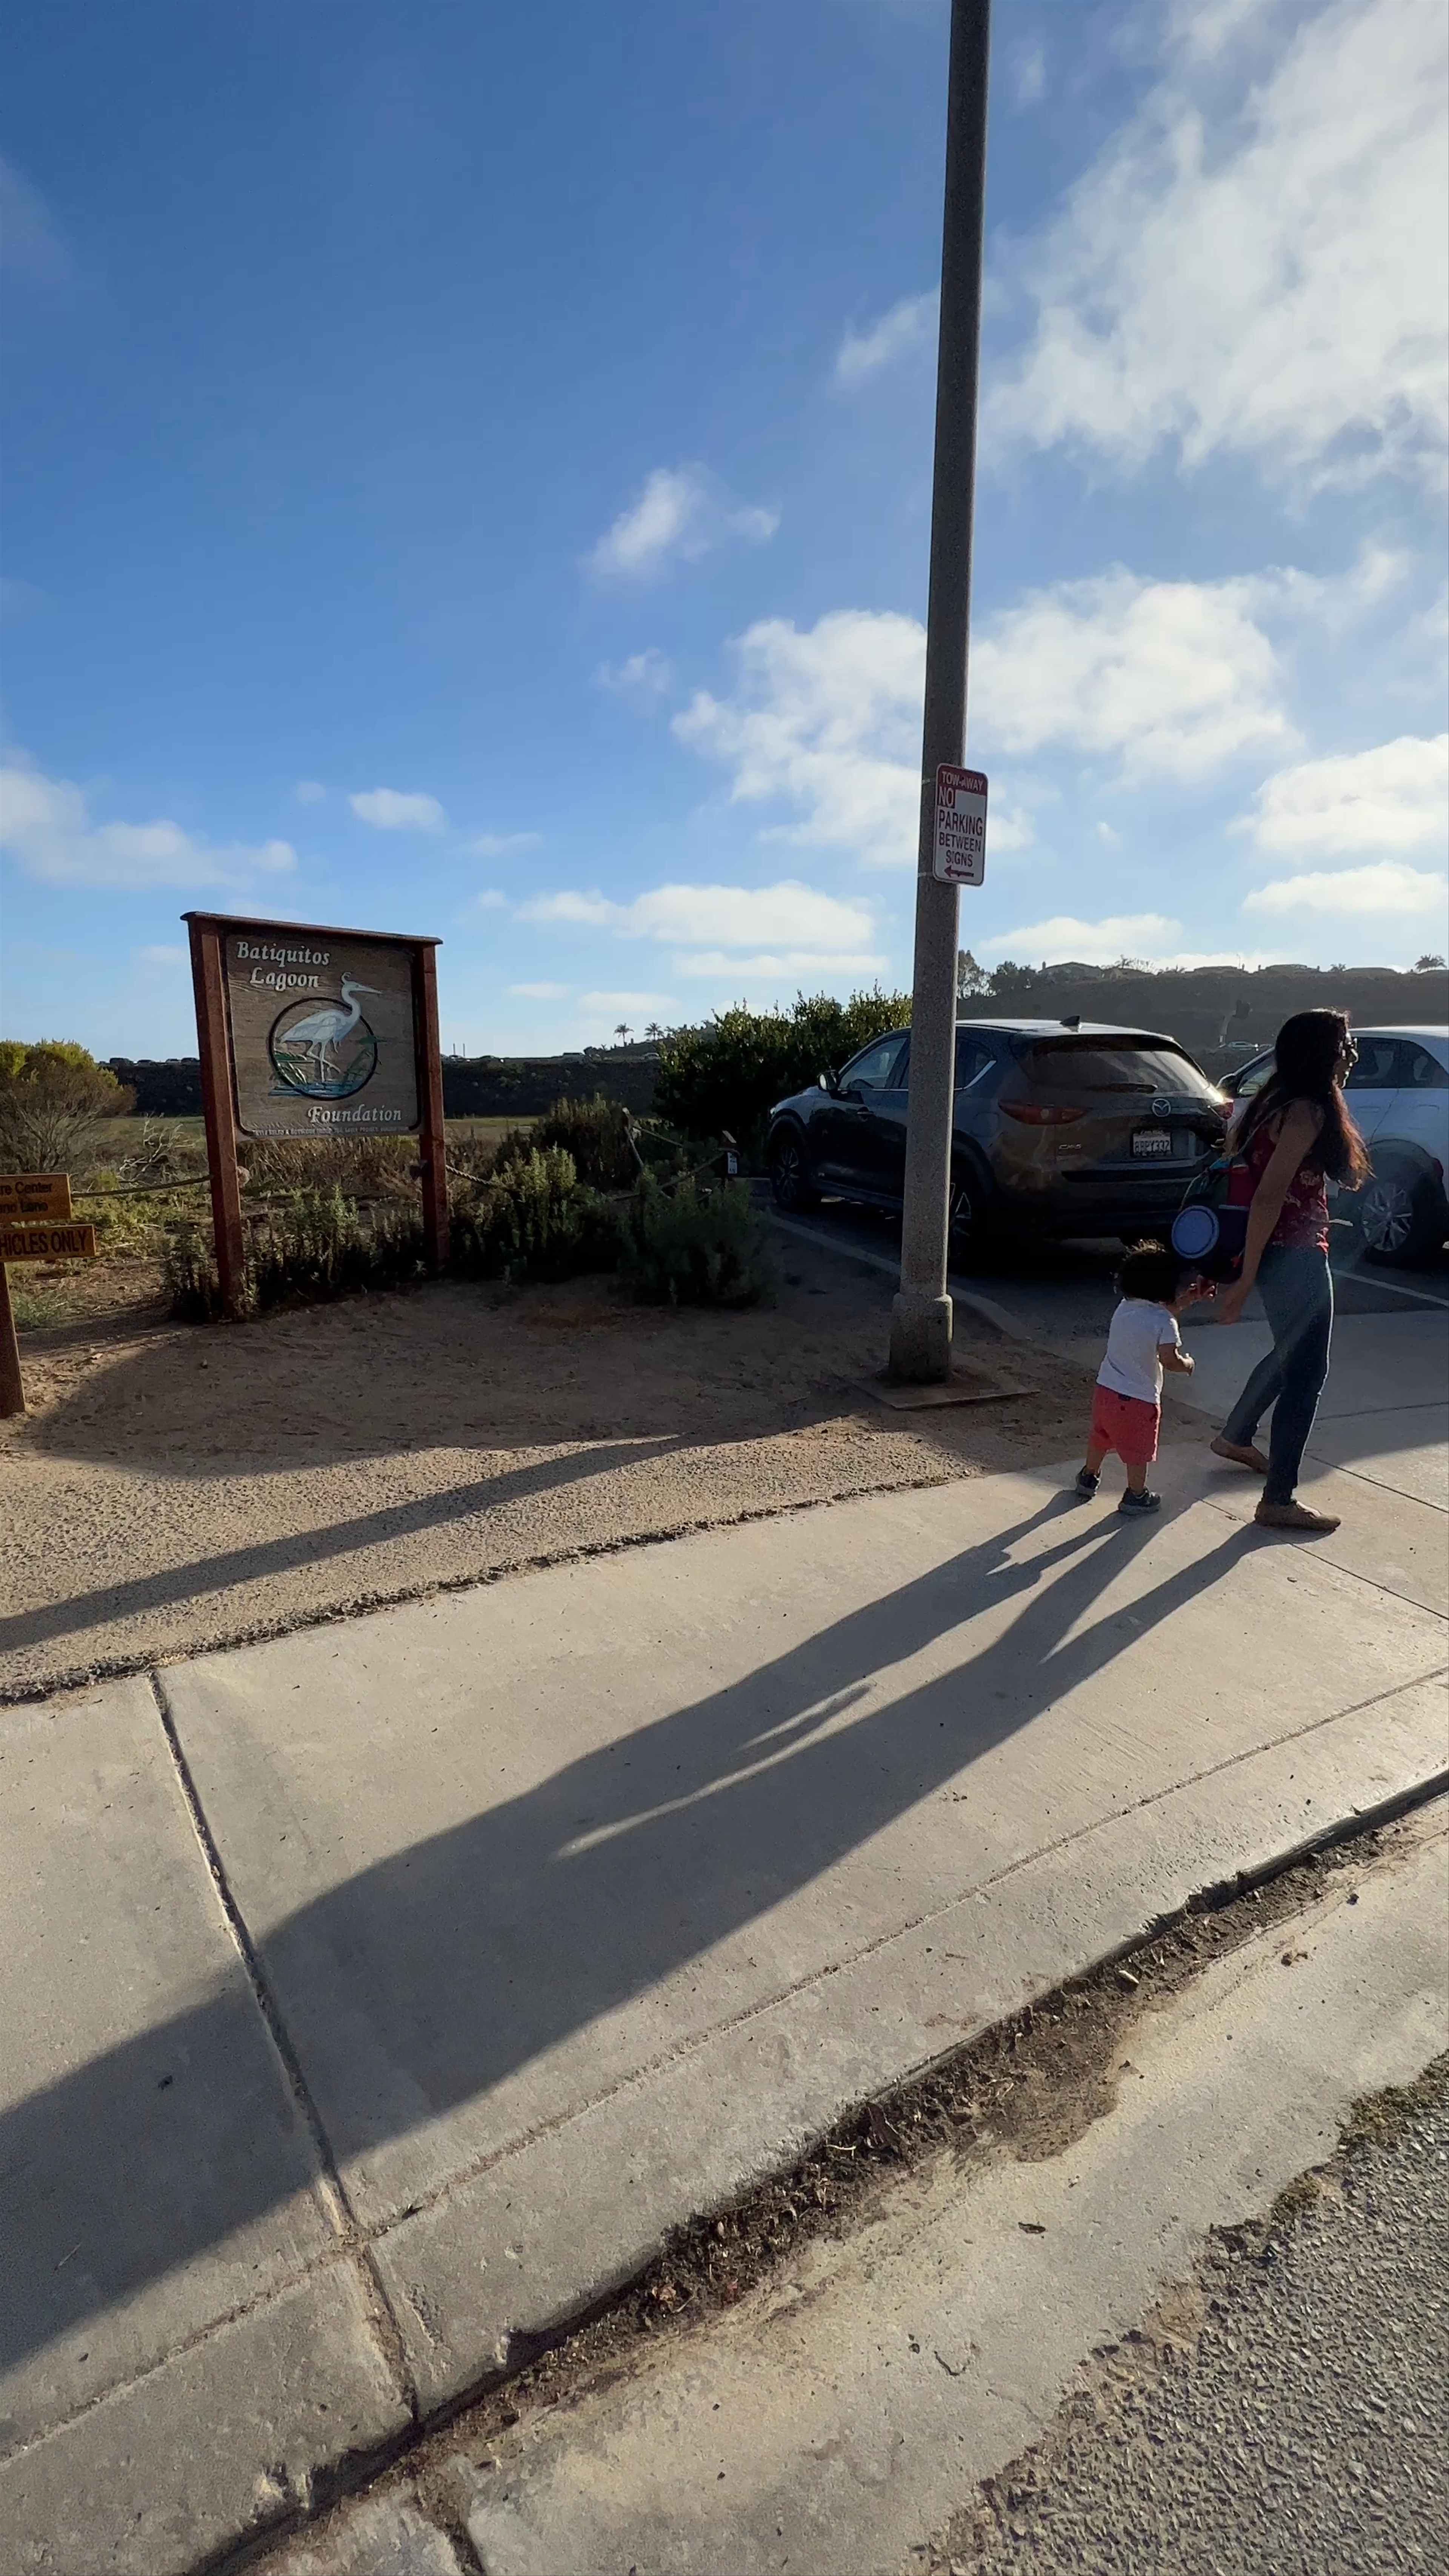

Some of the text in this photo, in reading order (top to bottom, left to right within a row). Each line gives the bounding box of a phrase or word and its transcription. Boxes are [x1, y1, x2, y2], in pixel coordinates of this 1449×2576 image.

[942, 771, 983, 791] TOW-AWAY
[938, 786, 954, 807] NO
[938, 810, 983, 836] PARKING
[939, 832, 981, 852] BETWEEN
[946, 850, 974, 867] SIGNS
[237, 941, 331, 967] Batiquitos
[249, 967, 319, 992] Lagoon
[307, 1104, 401, 1123] Foundation
[15, 1181, 52, 1193] Center
[51, 1229, 87, 1253] ONLY
